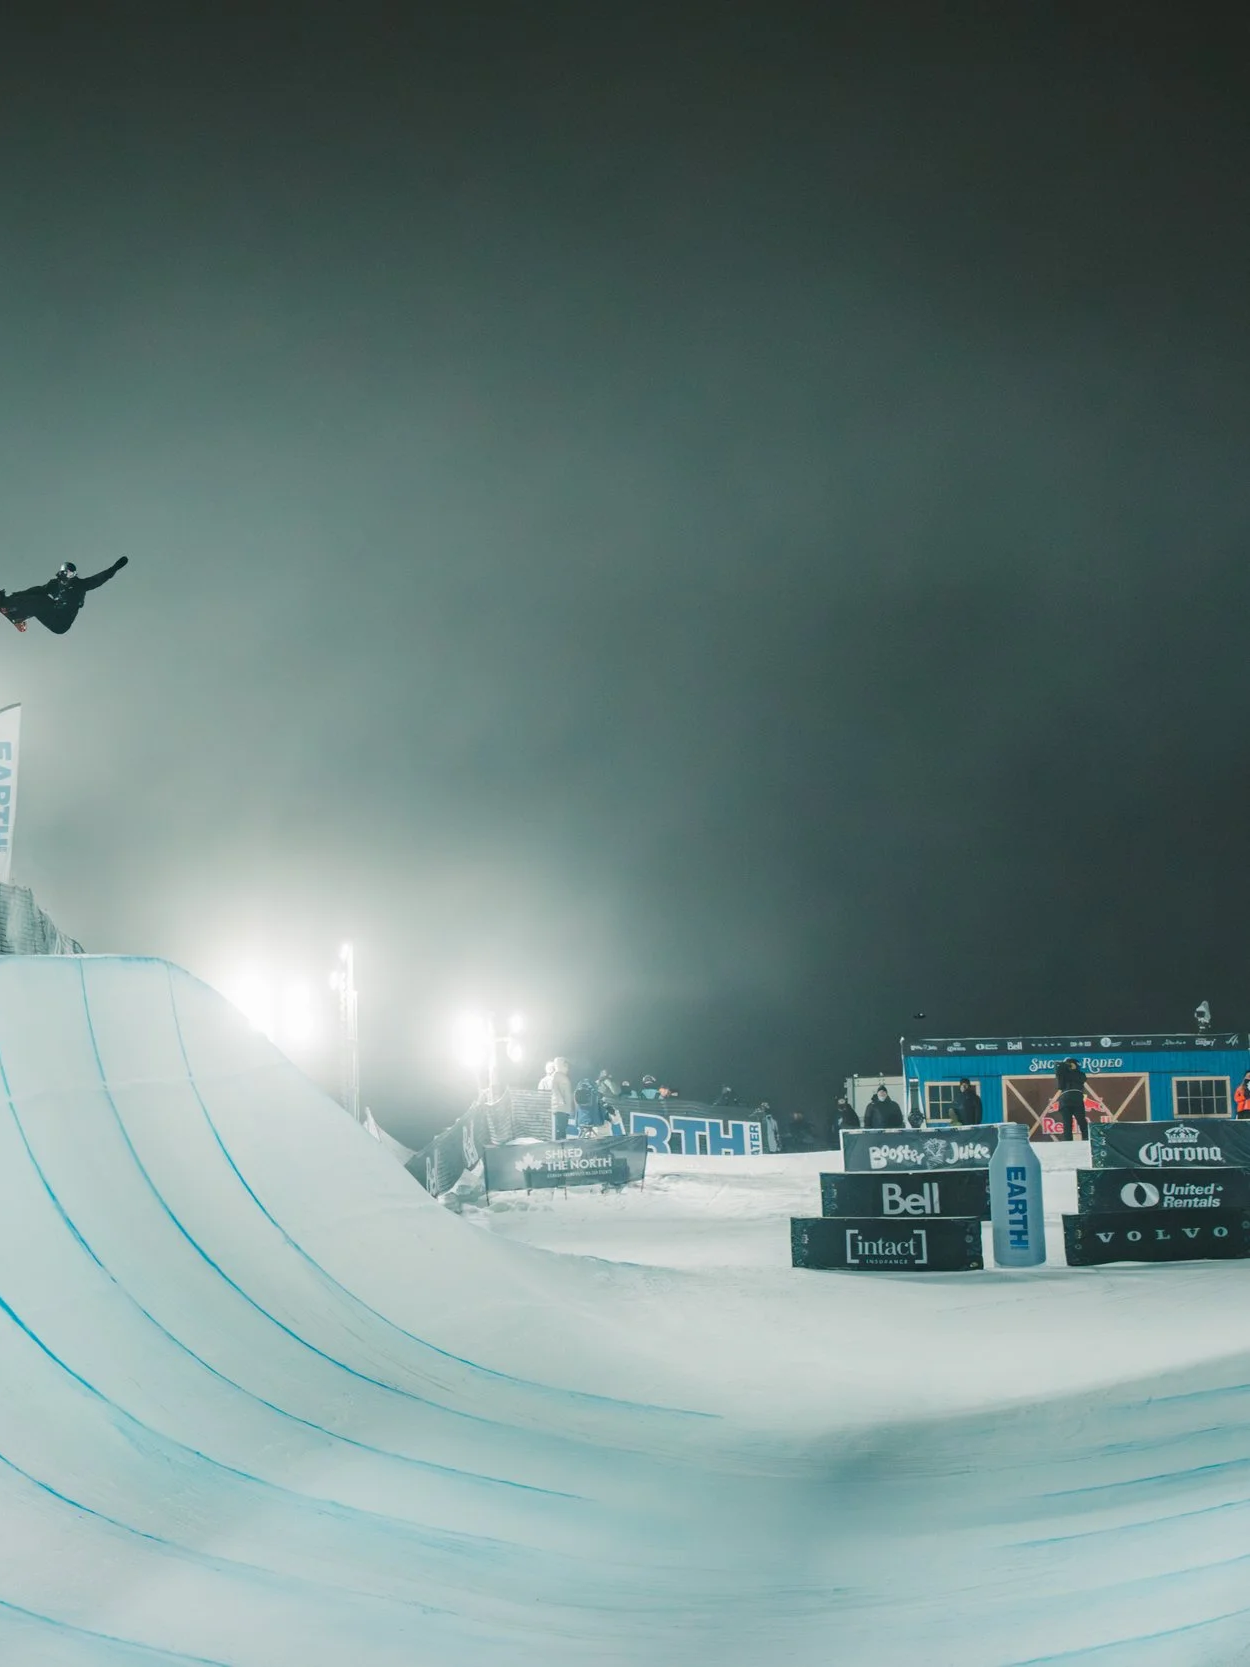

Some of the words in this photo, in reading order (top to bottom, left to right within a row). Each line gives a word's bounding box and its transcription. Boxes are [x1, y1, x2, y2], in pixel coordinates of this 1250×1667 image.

[1083, 1058, 1123, 1073] RODEO
[545, 1148, 583, 1160] SHRED
[868, 1145, 925, 1169] Booster
[945, 1142, 991, 1164] Juice
[1138, 1142, 1224, 1167] Corona
[546, 1161, 568, 1171] THE
[570, 1157, 612, 1169] NORTH
[1162, 1183, 1215, 1195] United
[882, 1183, 941, 1214] Bell
[1006, 1166, 1029, 1245] EARTH
[1162, 1196, 1221, 1208] Rentals
[1096, 1226, 1229, 1243] VOLVO
